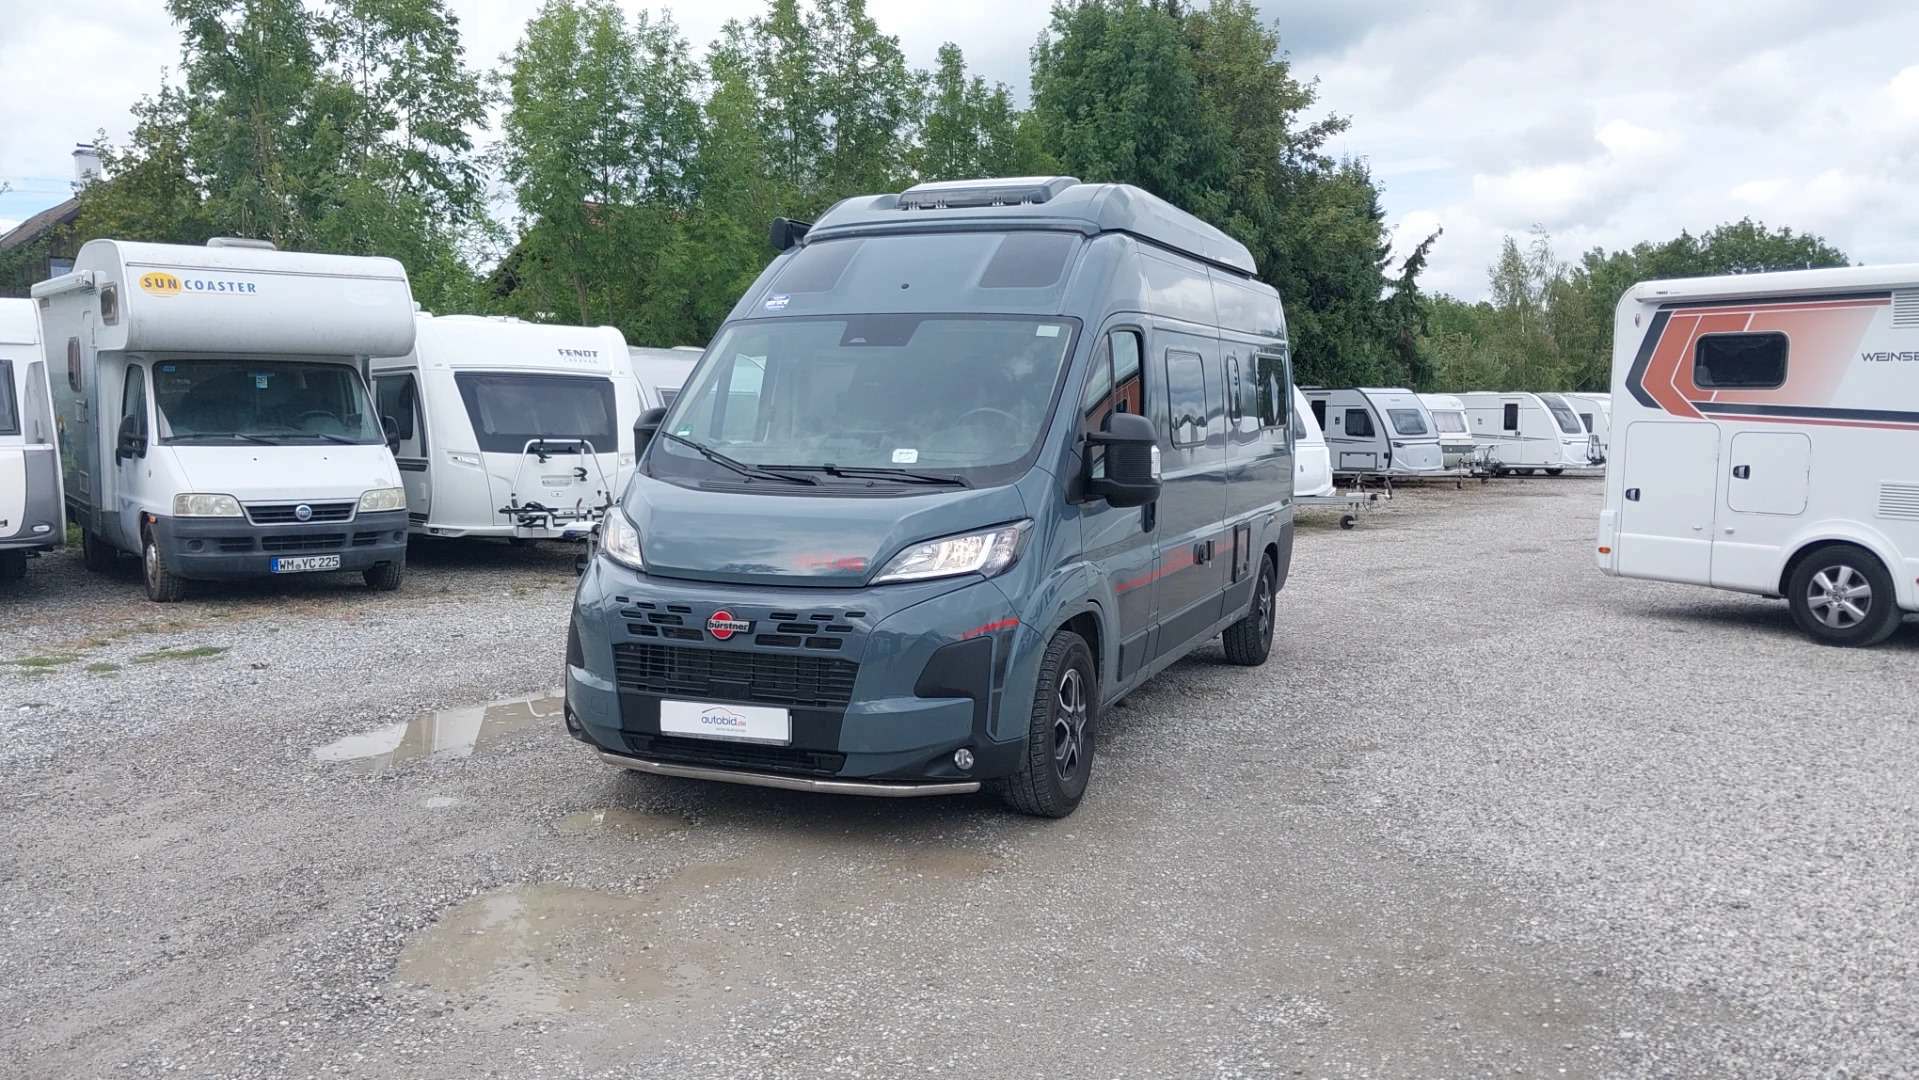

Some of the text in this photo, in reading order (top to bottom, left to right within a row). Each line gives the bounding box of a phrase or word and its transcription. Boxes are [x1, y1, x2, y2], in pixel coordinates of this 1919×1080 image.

[144, 277, 257, 293] SUN COASTER
[557, 348, 599, 358] FENDT
[279, 556, 339, 571] WM YC 225
[708, 620, 749, 631] bürstner
